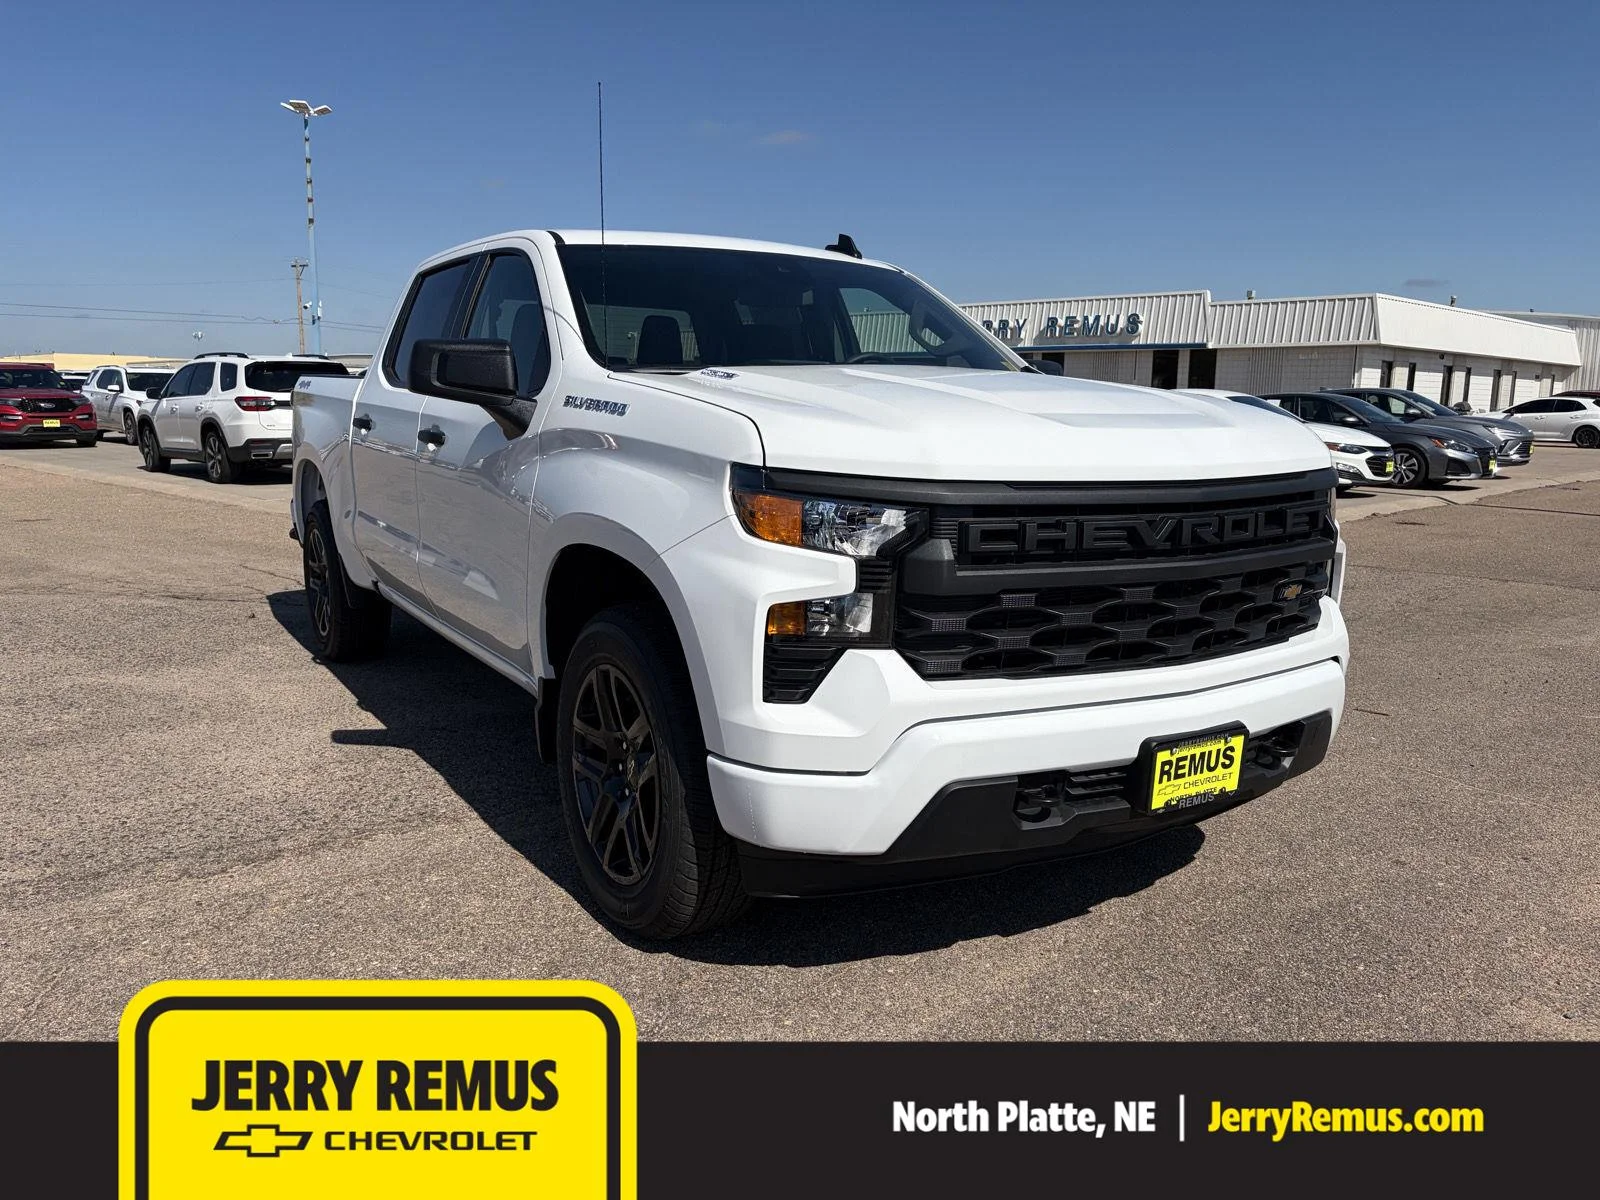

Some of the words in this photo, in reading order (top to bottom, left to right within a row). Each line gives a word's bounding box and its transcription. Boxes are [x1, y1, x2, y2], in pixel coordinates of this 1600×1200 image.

[1045, 313, 1143, 337] REMUS
[967, 507, 1327, 553] CHEVROLET
[1158, 745, 1235, 784] REMUS
[1183, 772, 1233, 789] CHEVROLET
[1178, 793, 1215, 809] REMUS
